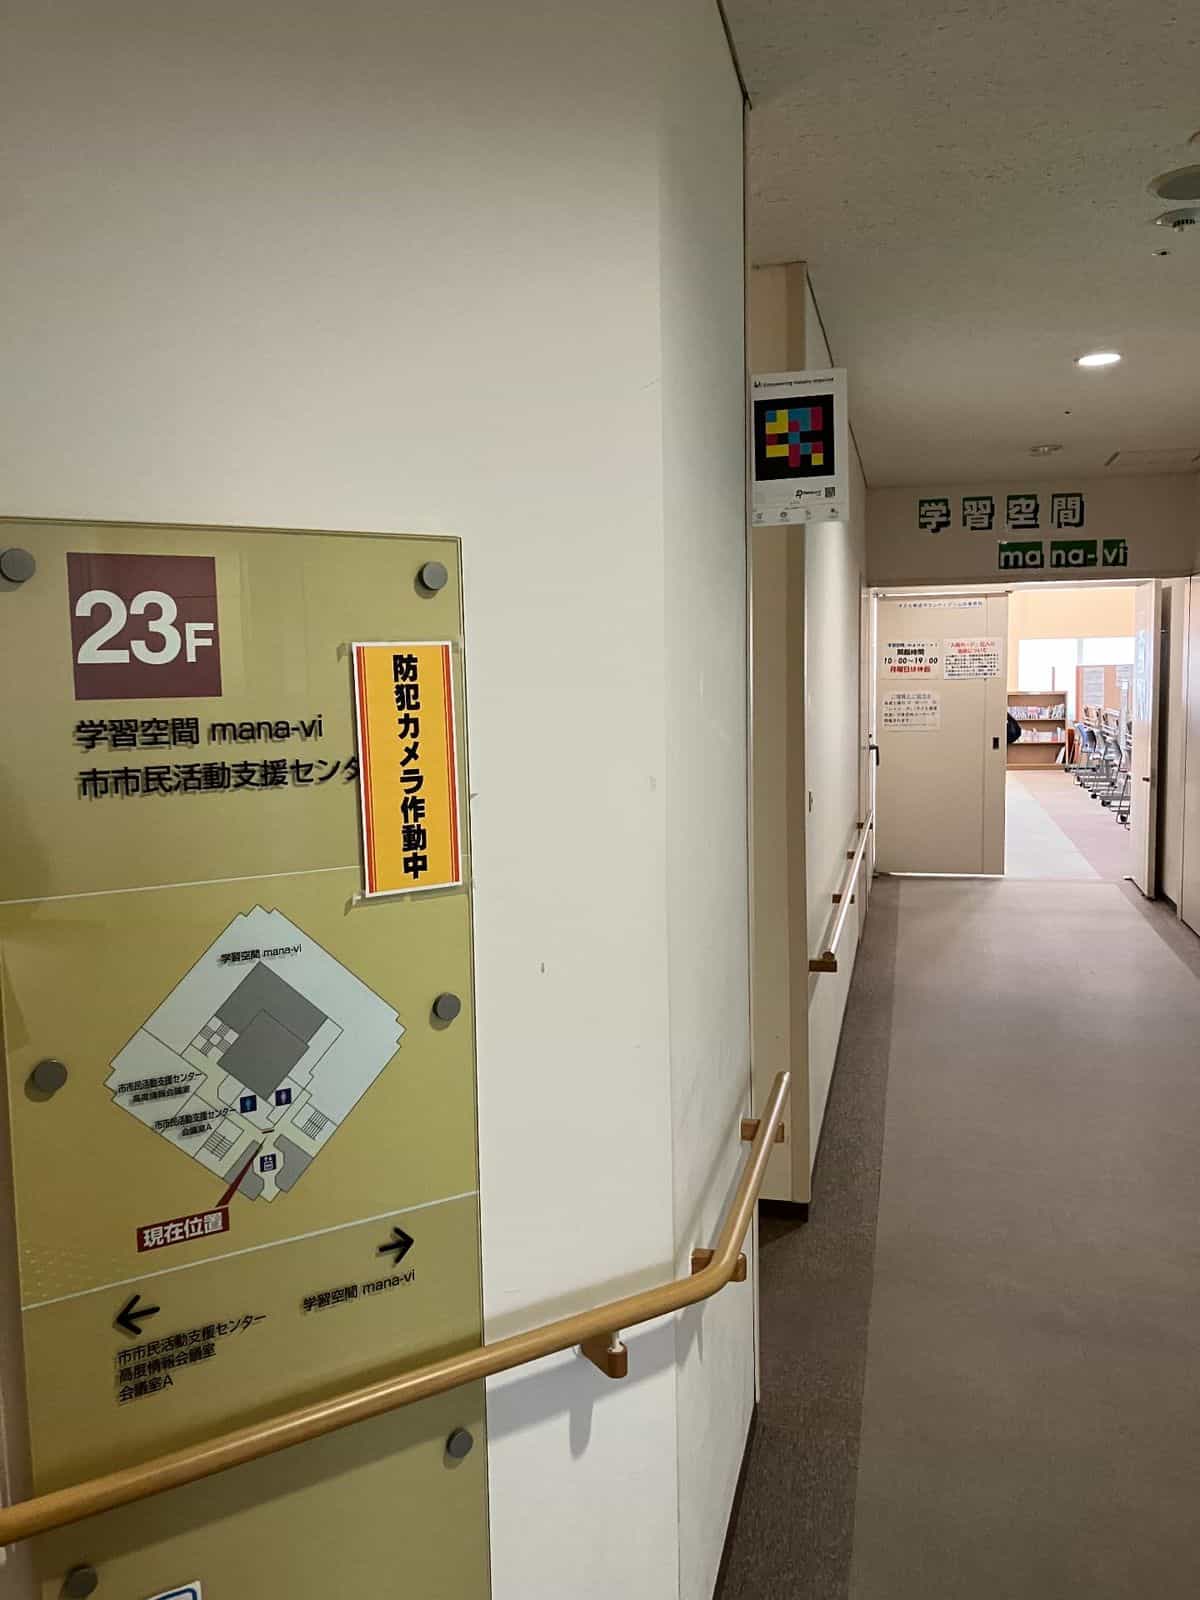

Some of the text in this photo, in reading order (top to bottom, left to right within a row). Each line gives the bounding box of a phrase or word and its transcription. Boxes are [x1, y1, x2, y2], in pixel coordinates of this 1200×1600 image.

[919, 493, 1085, 532] 学習空間
[999, 541, 1127, 569] mana-vi
[75, 589, 215, 665] 23F
[76, 714, 323, 750] 学習空間 mana-vi
[392, 654, 429, 879] 防犯カメラ作動中
[221, 943, 303, 964] 学習空間 mana-vi
[143, 1212, 225, 1248] 現在位置
[303, 1268, 415, 1312] 学習空間 mana-vi
[118, 1314, 267, 1367] 市市民活動支援センター
[118, 1343, 217, 1383] 高度情報会議室
[118, 1376, 174, 1404] 会議室A
